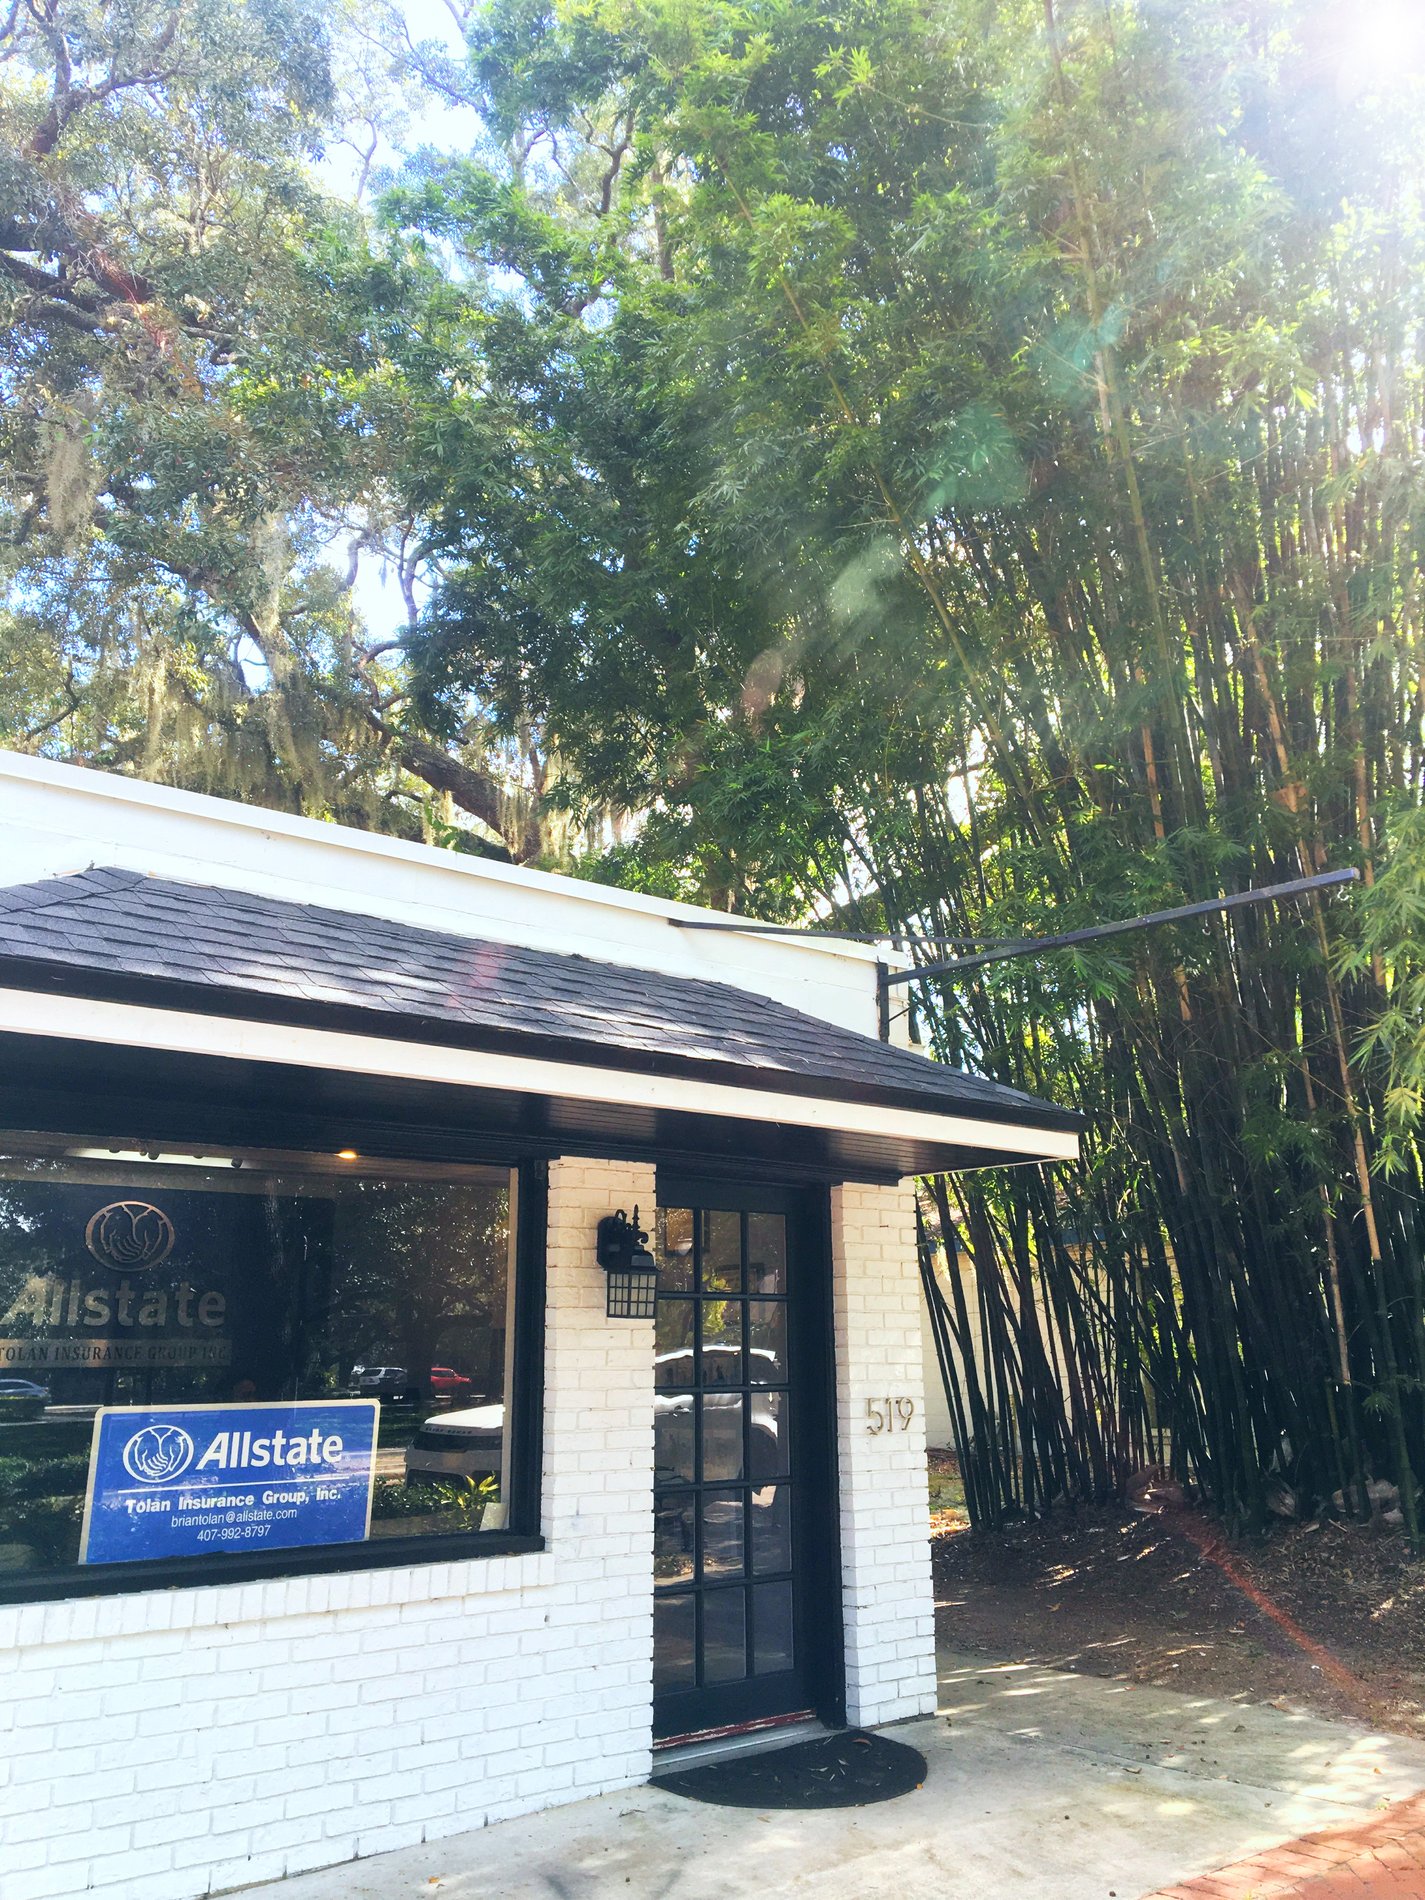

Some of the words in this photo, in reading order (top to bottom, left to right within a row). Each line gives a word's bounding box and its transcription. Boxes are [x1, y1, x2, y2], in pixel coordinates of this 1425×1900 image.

[0, 1275, 226, 1327] Allstate
[54, 1346, 142, 1362] INSURANCE
[866, 1397, 914, 1436] 519
[195, 1428, 343, 1471] Allstate
[125, 1499, 171, 1514] Tolan
[178, 1494, 254, 1510] Insurance
[262, 1489, 310, 1506] Group,
[315, 1487, 342, 1501] Inc.
[171, 1508, 297, 1528] briantolan@allstate.com
[197, 1525, 271, 1541] 407-992-8797
